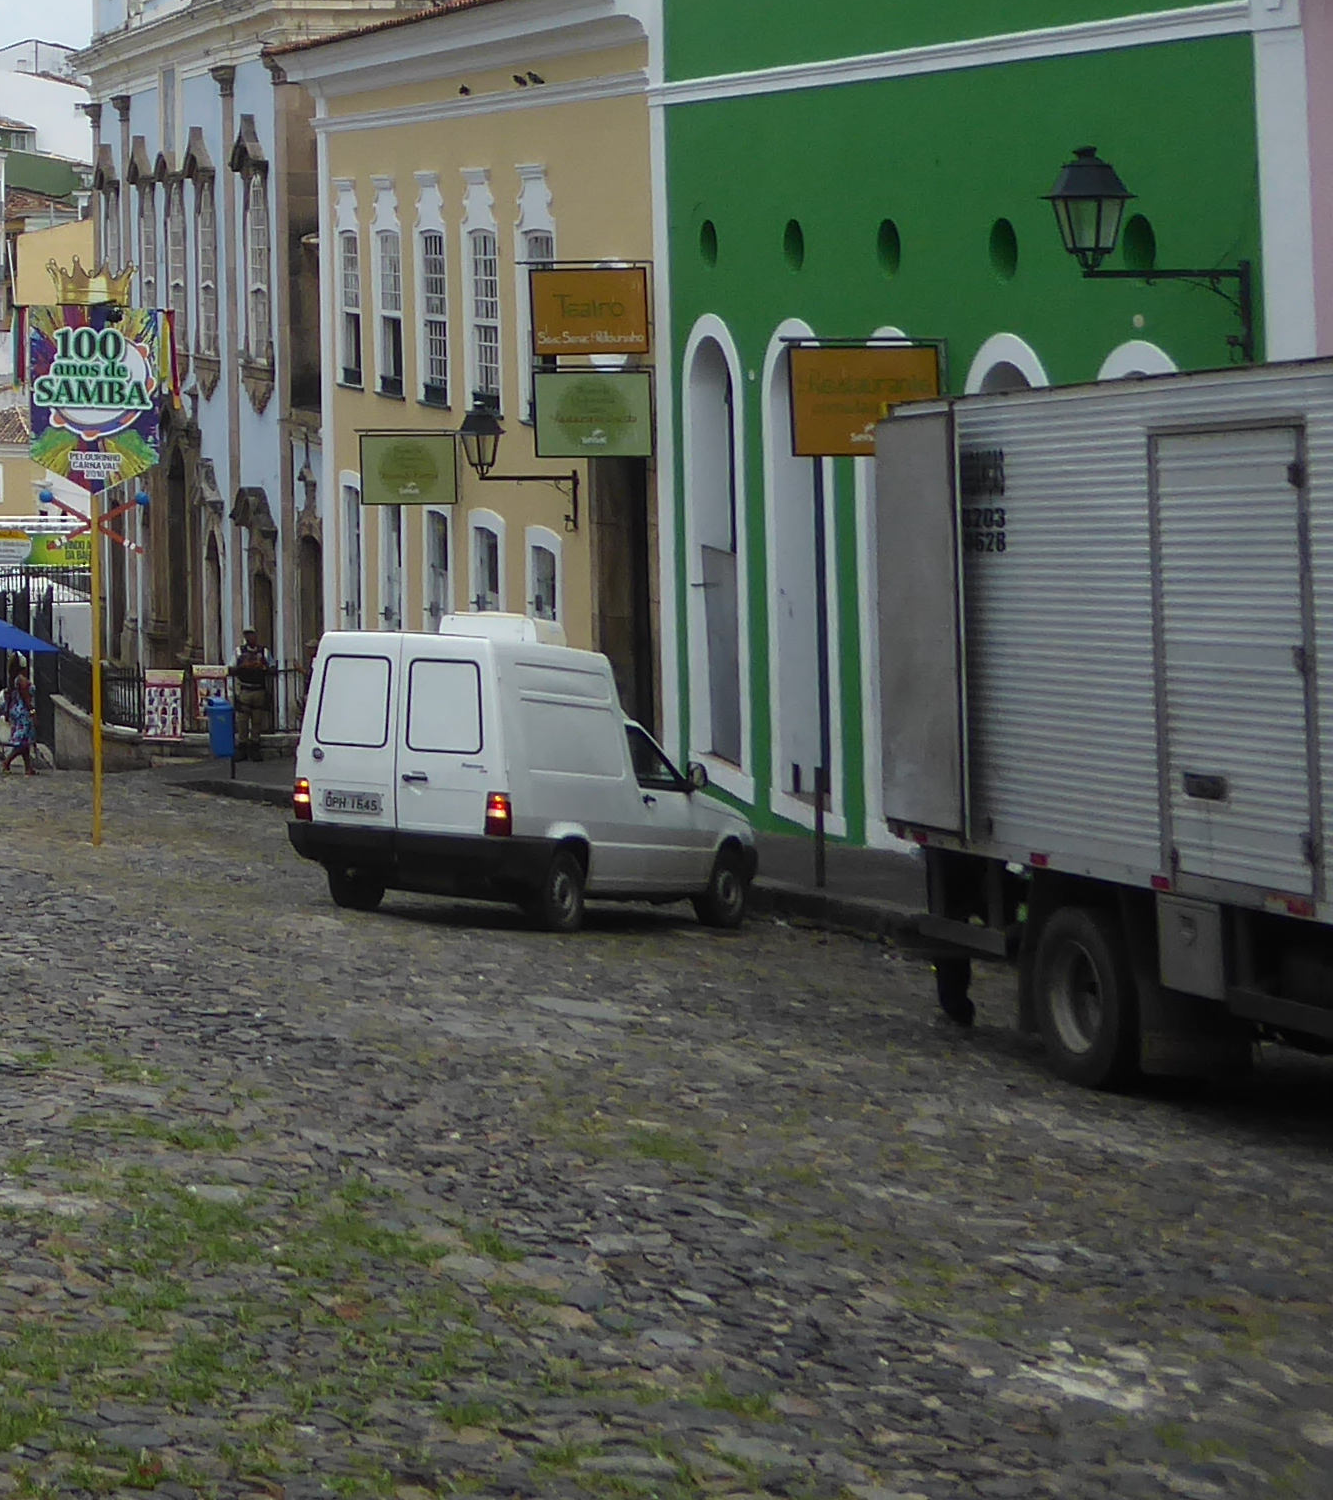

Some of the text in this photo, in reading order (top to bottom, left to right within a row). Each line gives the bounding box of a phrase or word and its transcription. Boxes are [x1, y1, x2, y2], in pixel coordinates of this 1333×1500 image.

[54, 329, 124, 362] 100
[53, 361, 129, 378] anos de
[36, 378, 151, 406] SAMBA
[70, 452, 121, 462] PELOURINHO
[72, 461, 116, 470] CARNAVAL
